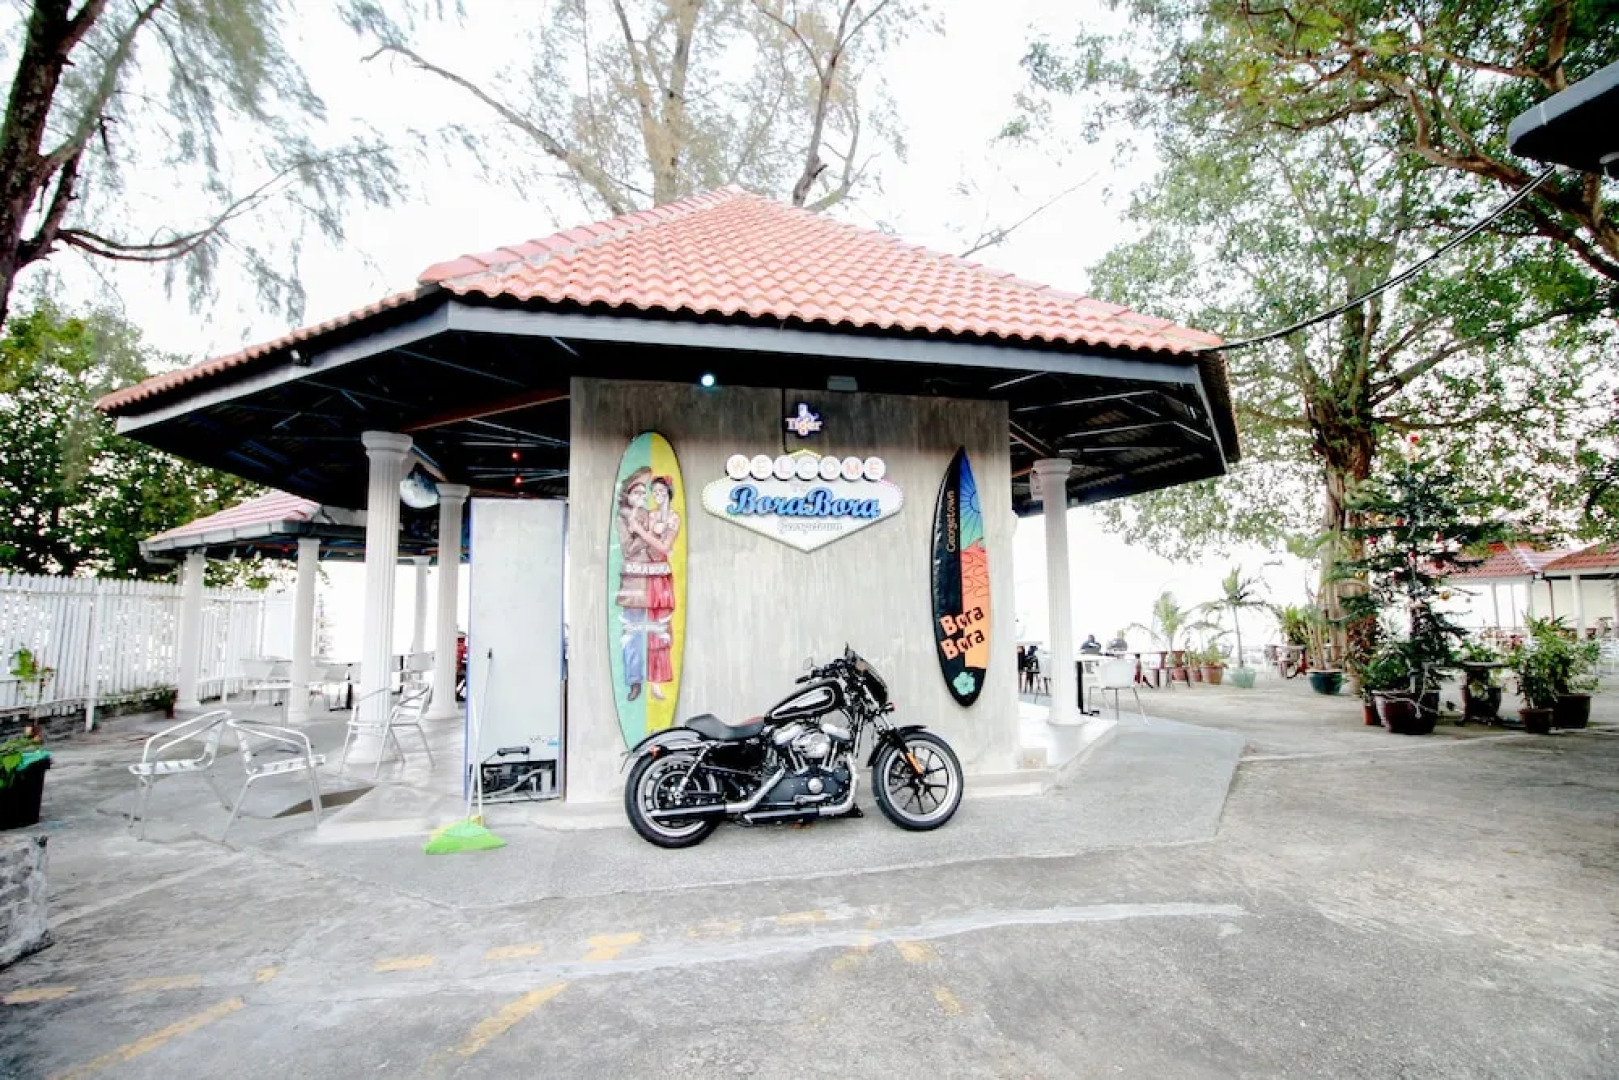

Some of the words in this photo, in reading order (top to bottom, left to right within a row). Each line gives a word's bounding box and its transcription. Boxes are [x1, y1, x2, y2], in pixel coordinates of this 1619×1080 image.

[785, 417, 823, 436] Tiger
[729, 456, 883, 479] WELCOME
[940, 606, 984, 637] Bora
[940, 629, 985, 660] Bora
